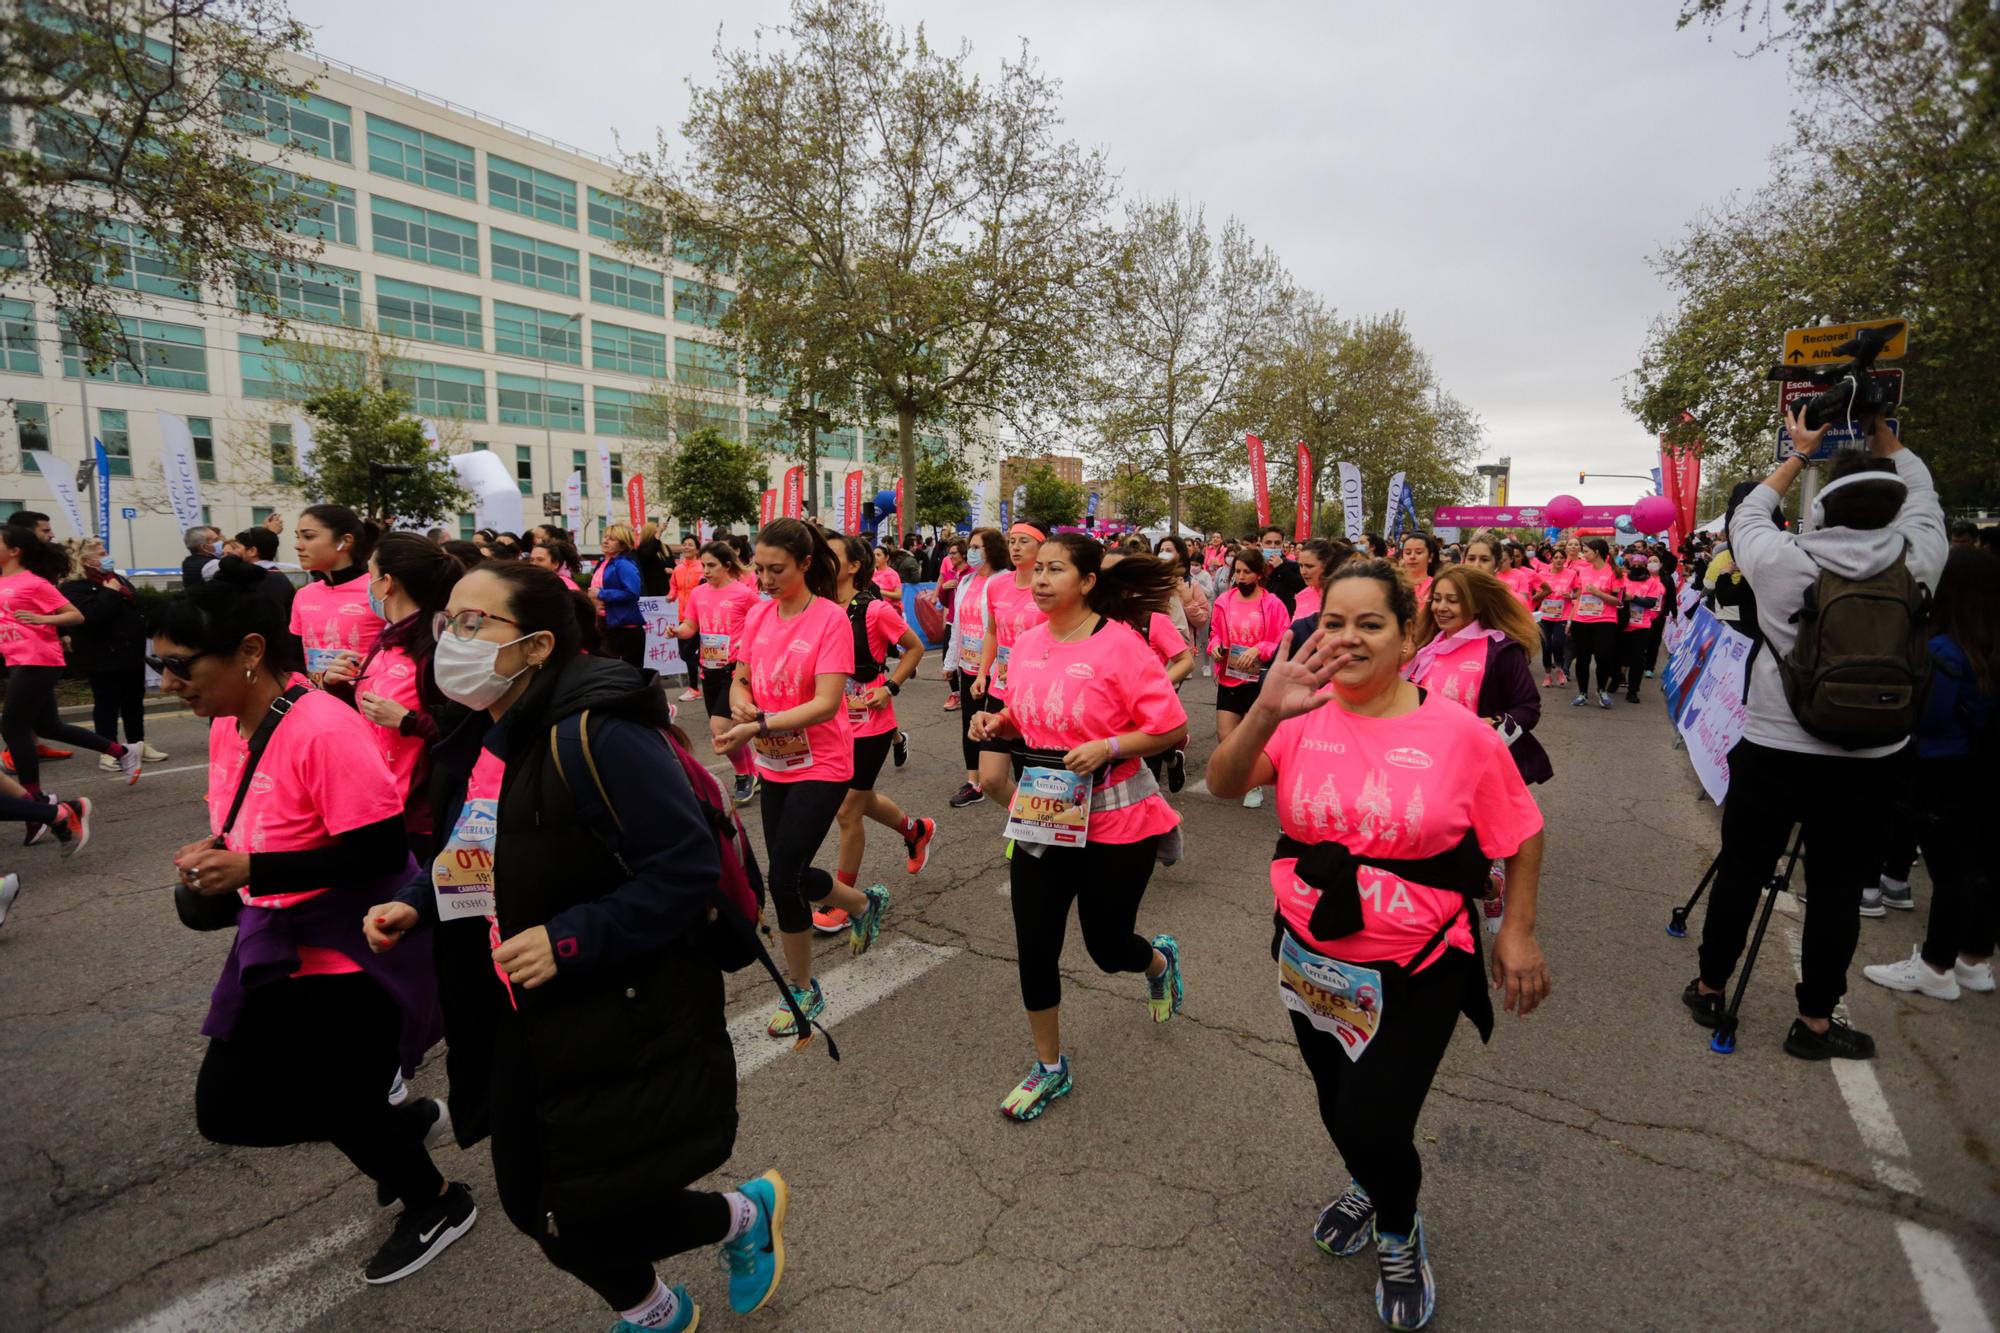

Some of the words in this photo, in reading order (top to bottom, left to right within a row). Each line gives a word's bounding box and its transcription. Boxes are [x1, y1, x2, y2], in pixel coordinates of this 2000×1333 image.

[1802, 332, 1848, 344] Rectorat
[125, 509, 134, 518] P
[1031, 796, 1064, 813] 016
[451, 899, 488, 909] OYSHO
[1302, 981, 1347, 1010] 016
